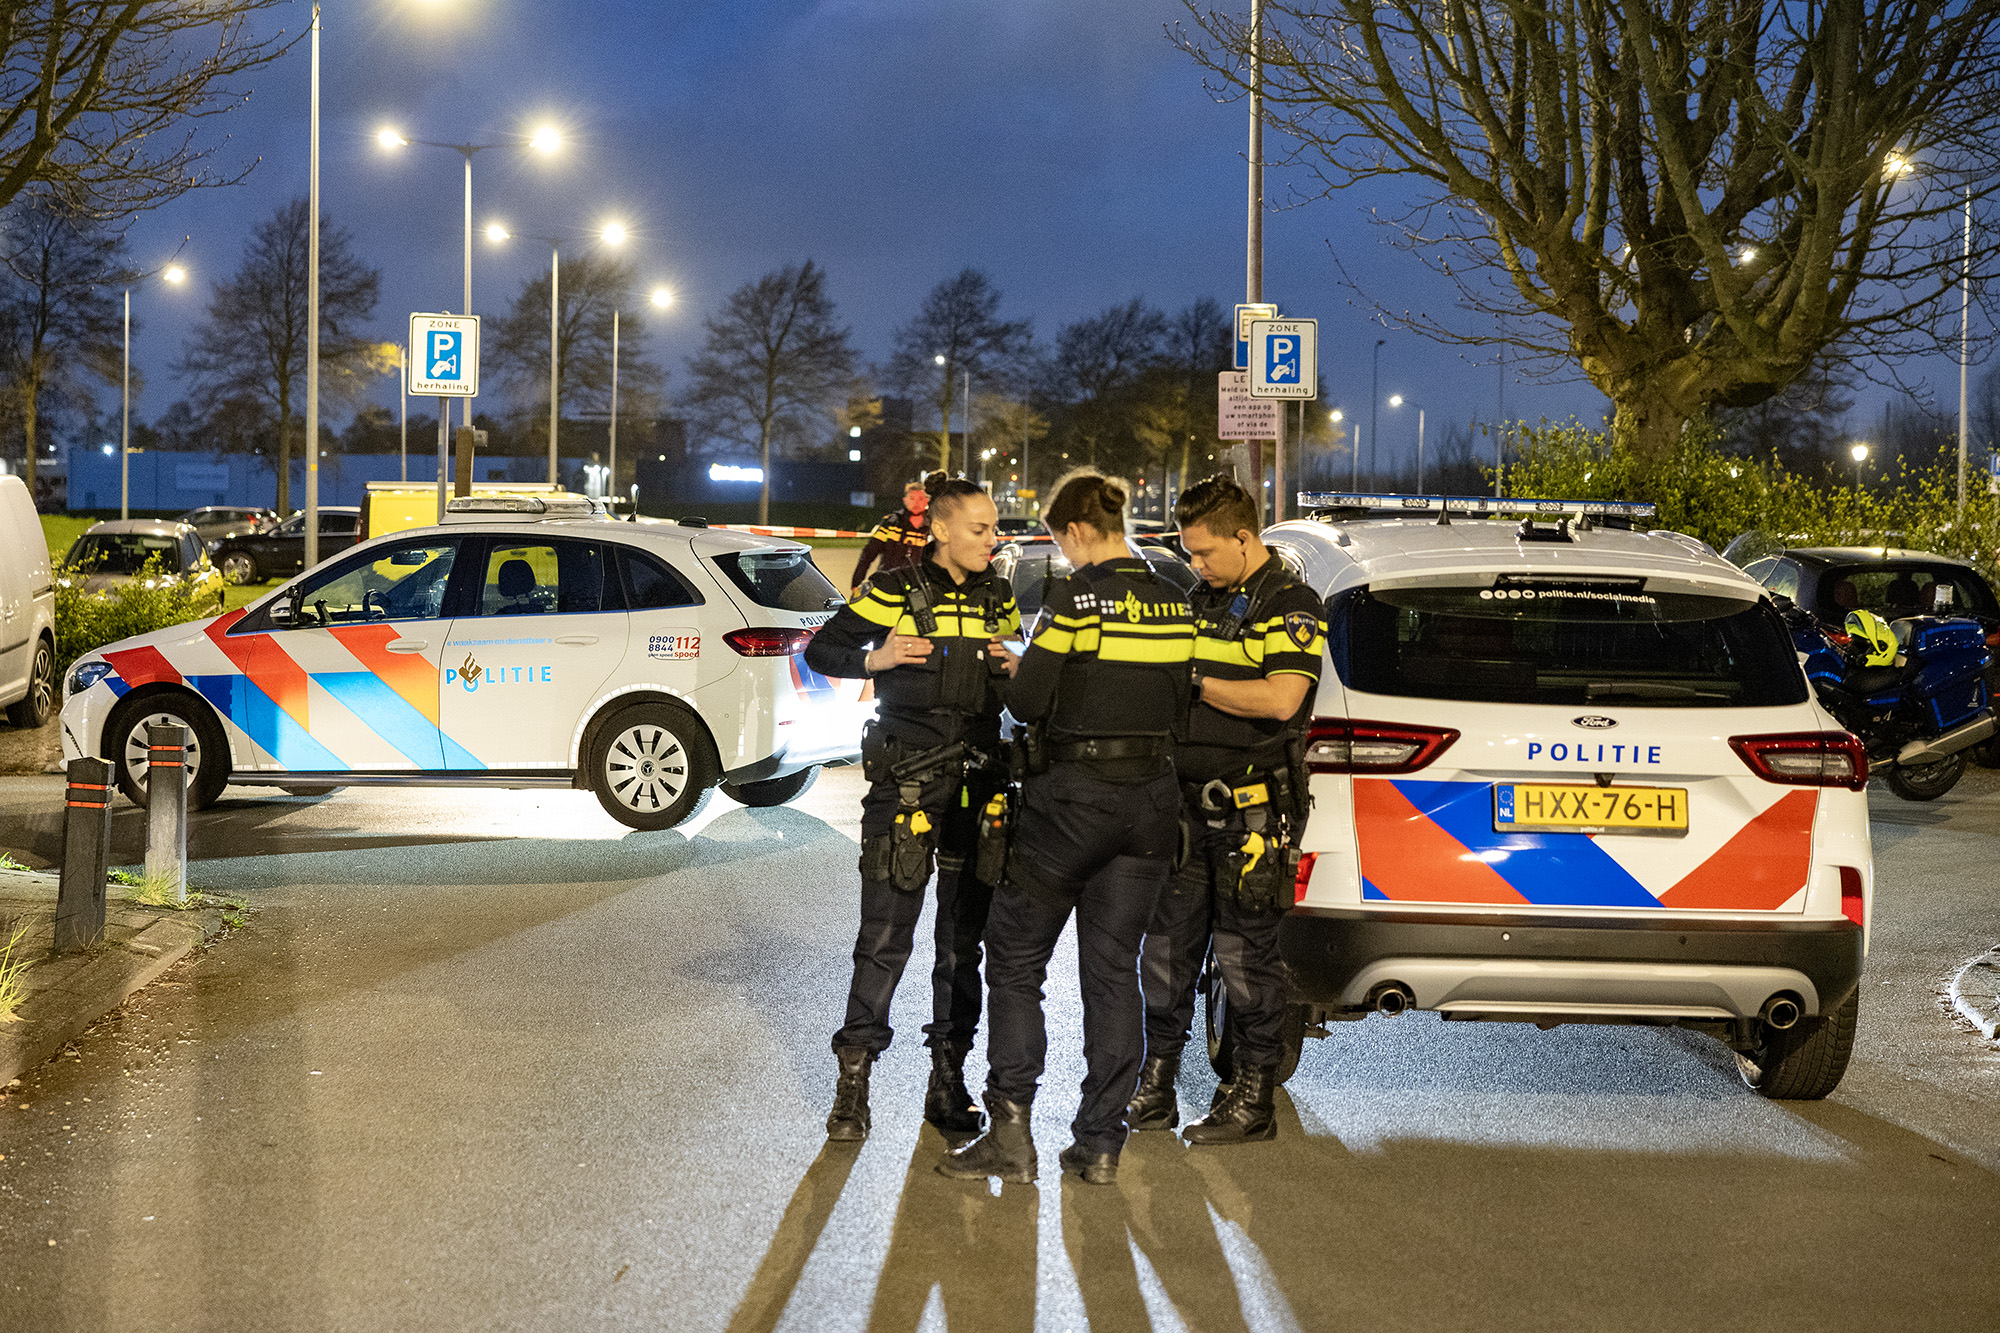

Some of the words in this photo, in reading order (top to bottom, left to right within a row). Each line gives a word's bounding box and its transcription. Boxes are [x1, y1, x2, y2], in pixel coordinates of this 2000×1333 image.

[430, 320, 460, 328] ZONE
[1268, 324, 1299, 332] ZONE
[433, 333, 454, 360] P
[1273, 338, 1293, 363] P
[1234, 375, 1248, 383] LE
[416, 382, 469, 392] herhaling
[1257, 386, 1308, 395] herhaling
[1538, 590, 1656, 604] politie.nl/socialmedia
[1115, 600, 1185, 623] POLITIE
[676, 636, 701, 649] 112
[674, 650, 700, 658] spoed
[446, 666, 552, 692] POLITIE
[1580, 716, 1610, 727] Ford
[1528, 742, 1661, 764] POLITIE
[1500, 807, 1513, 818] NL
[1525, 791, 1676, 821] HXX-76-H
